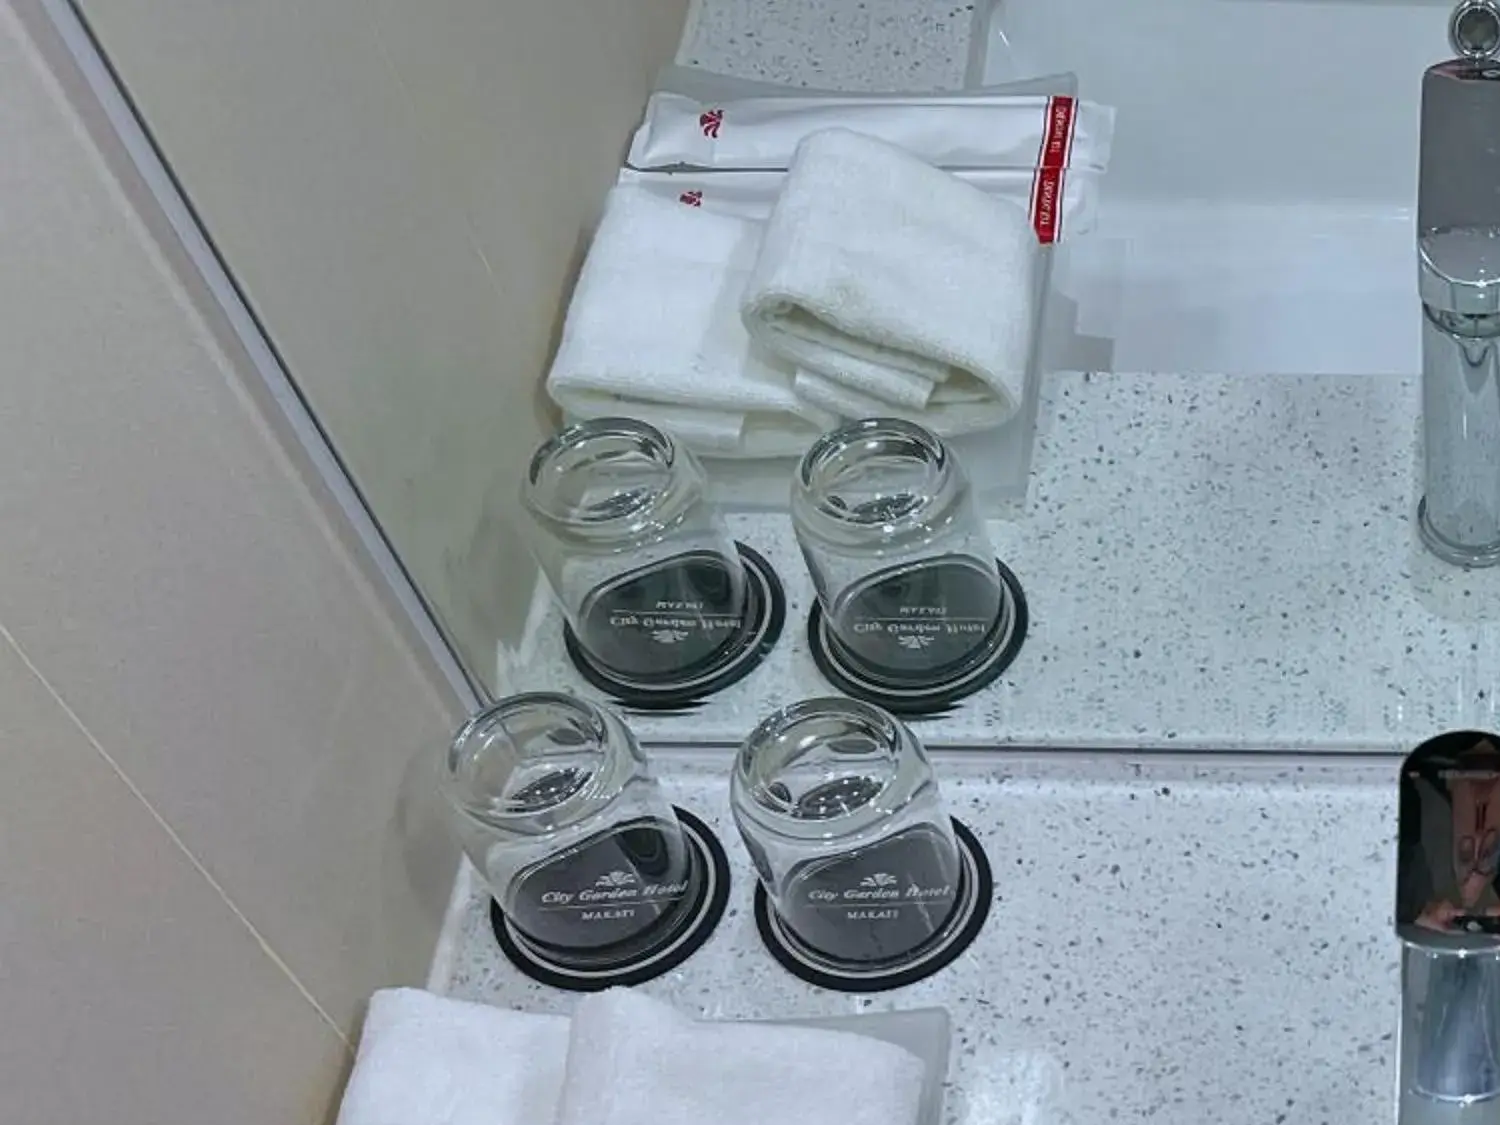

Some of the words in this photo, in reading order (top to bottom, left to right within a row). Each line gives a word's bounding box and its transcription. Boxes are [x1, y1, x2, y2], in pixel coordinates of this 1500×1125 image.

[541, 891, 574, 905] City
[579, 887, 638, 901] Garden
[642, 880, 689, 896] Hotel
[807, 889, 839, 902] City
[843, 886, 900, 899] Garden
[905, 884, 951, 898] Hotel
[581, 908, 636, 920] MAKATI
[847, 909, 900, 920] MAKATI
